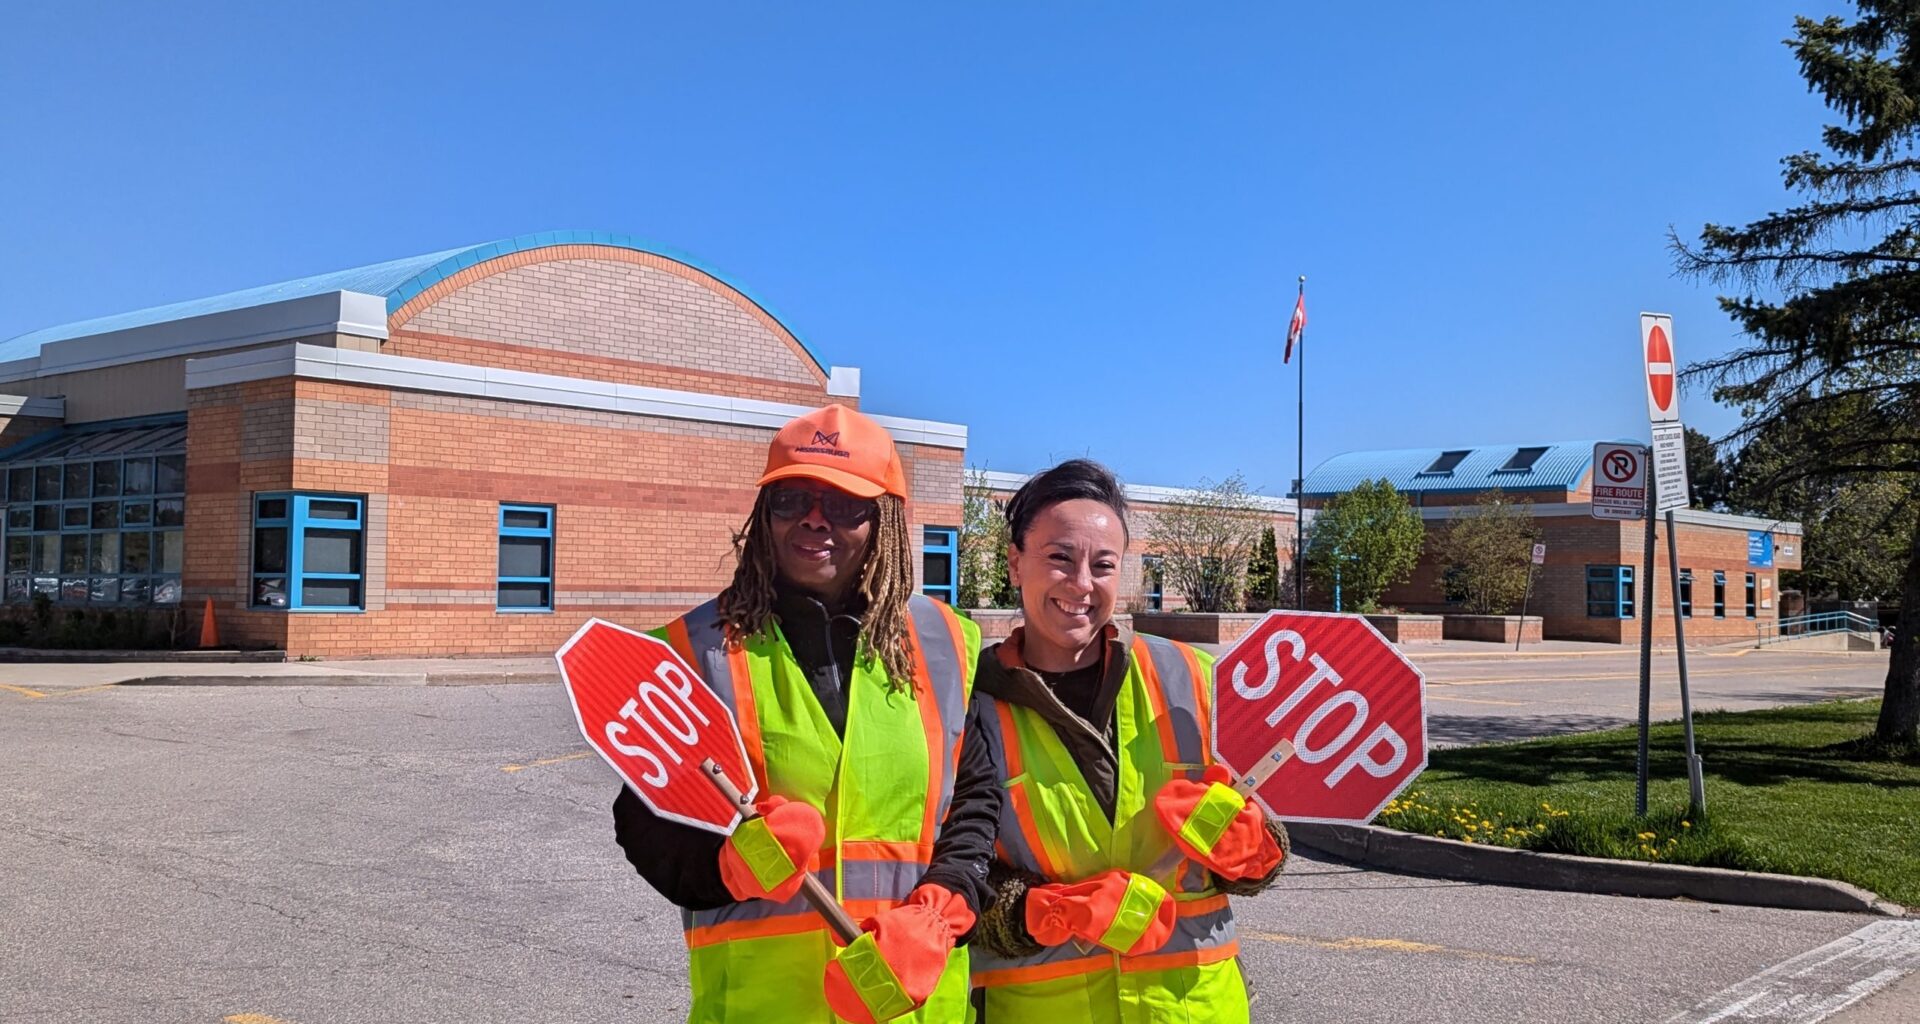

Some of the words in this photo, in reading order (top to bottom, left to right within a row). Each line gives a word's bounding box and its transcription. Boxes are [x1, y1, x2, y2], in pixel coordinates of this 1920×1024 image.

[1595, 487, 1614, 497] FIRE
[1616, 488, 1643, 498] ROUTE
[605, 660, 711, 788] STOP
[1232, 629, 1408, 789] STOP
